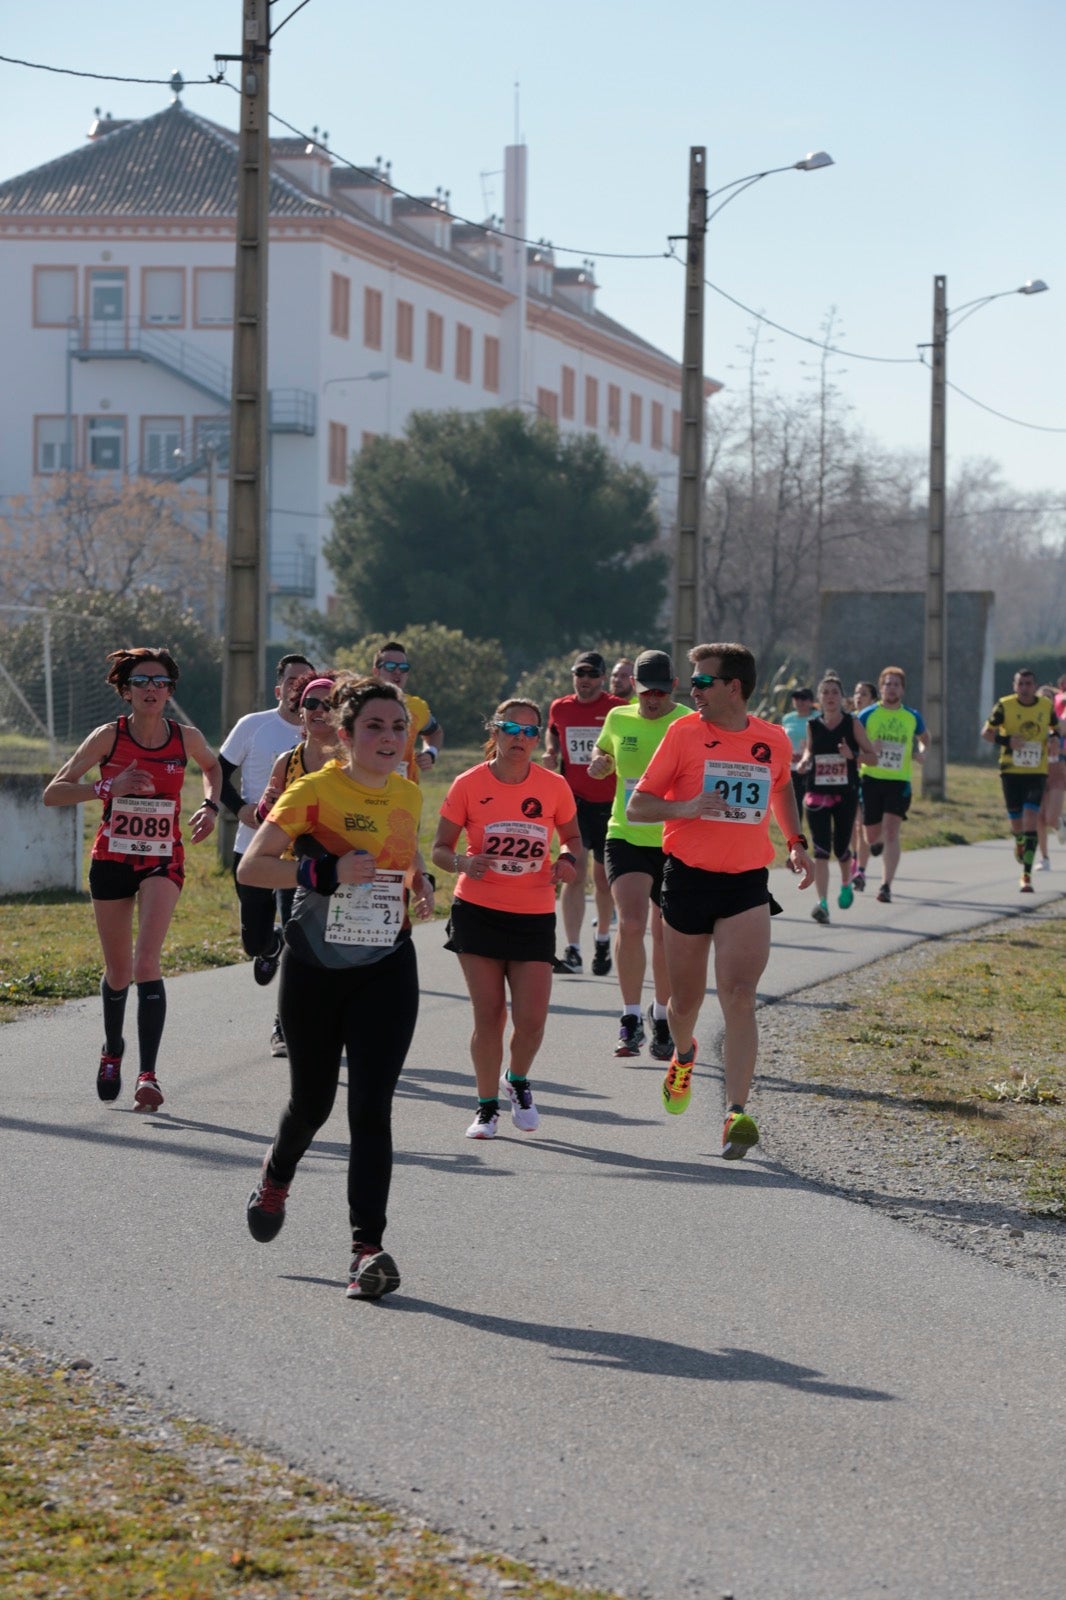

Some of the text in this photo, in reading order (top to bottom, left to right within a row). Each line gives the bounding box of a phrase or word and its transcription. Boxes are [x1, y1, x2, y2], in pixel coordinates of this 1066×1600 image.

[570, 739, 594, 752] 316
[715, 780, 760, 805] 913
[114, 814, 171, 838] 2089
[486, 837, 544, 858] 2226
[373, 894, 401, 902] CONTRA
